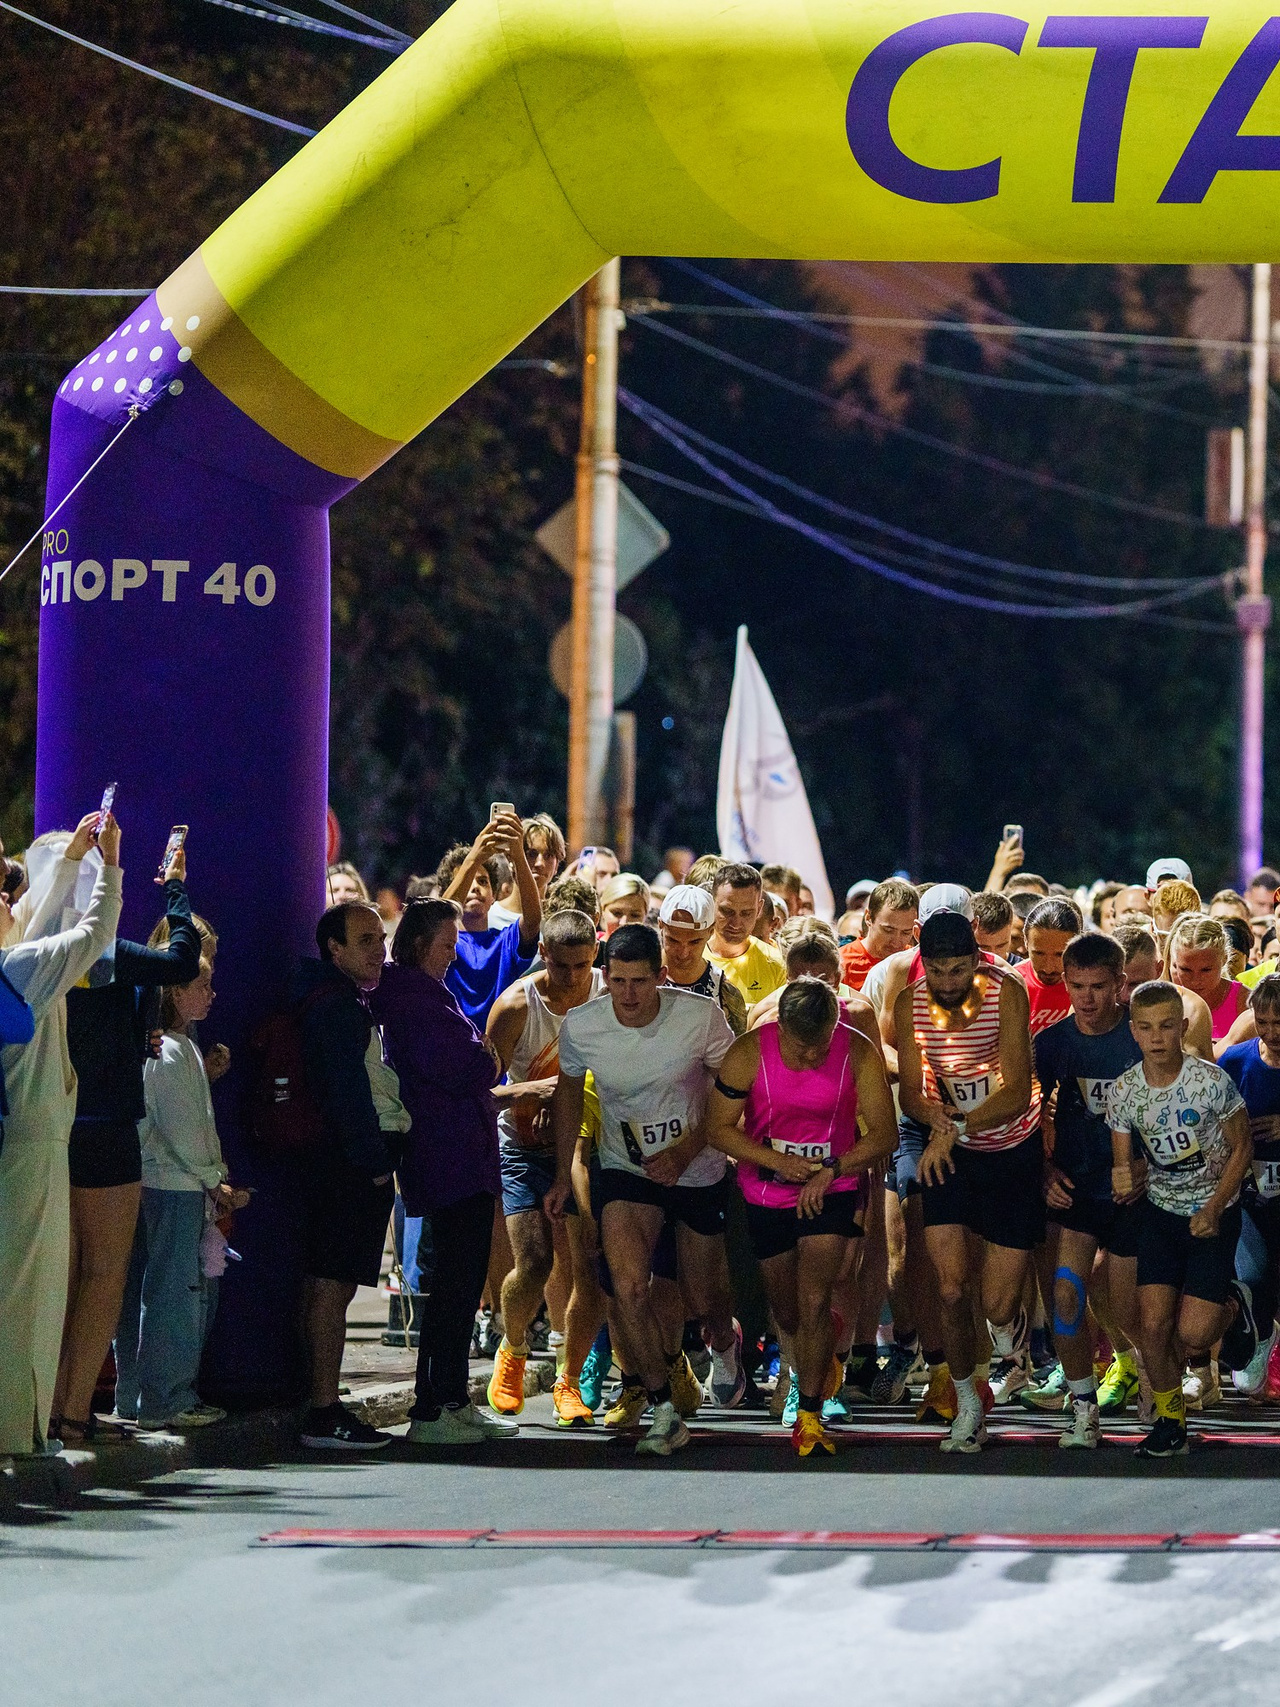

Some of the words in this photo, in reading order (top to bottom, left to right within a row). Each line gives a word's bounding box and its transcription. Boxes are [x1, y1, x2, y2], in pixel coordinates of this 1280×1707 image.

[43, 529, 69, 557] PRO
[41, 558, 190, 606] СПОРТ
[203, 562, 276, 606] 40
[953, 1076, 990, 1101] 577
[643, 1119, 683, 1145] 579
[1150, 1131, 1191, 1154] 219
